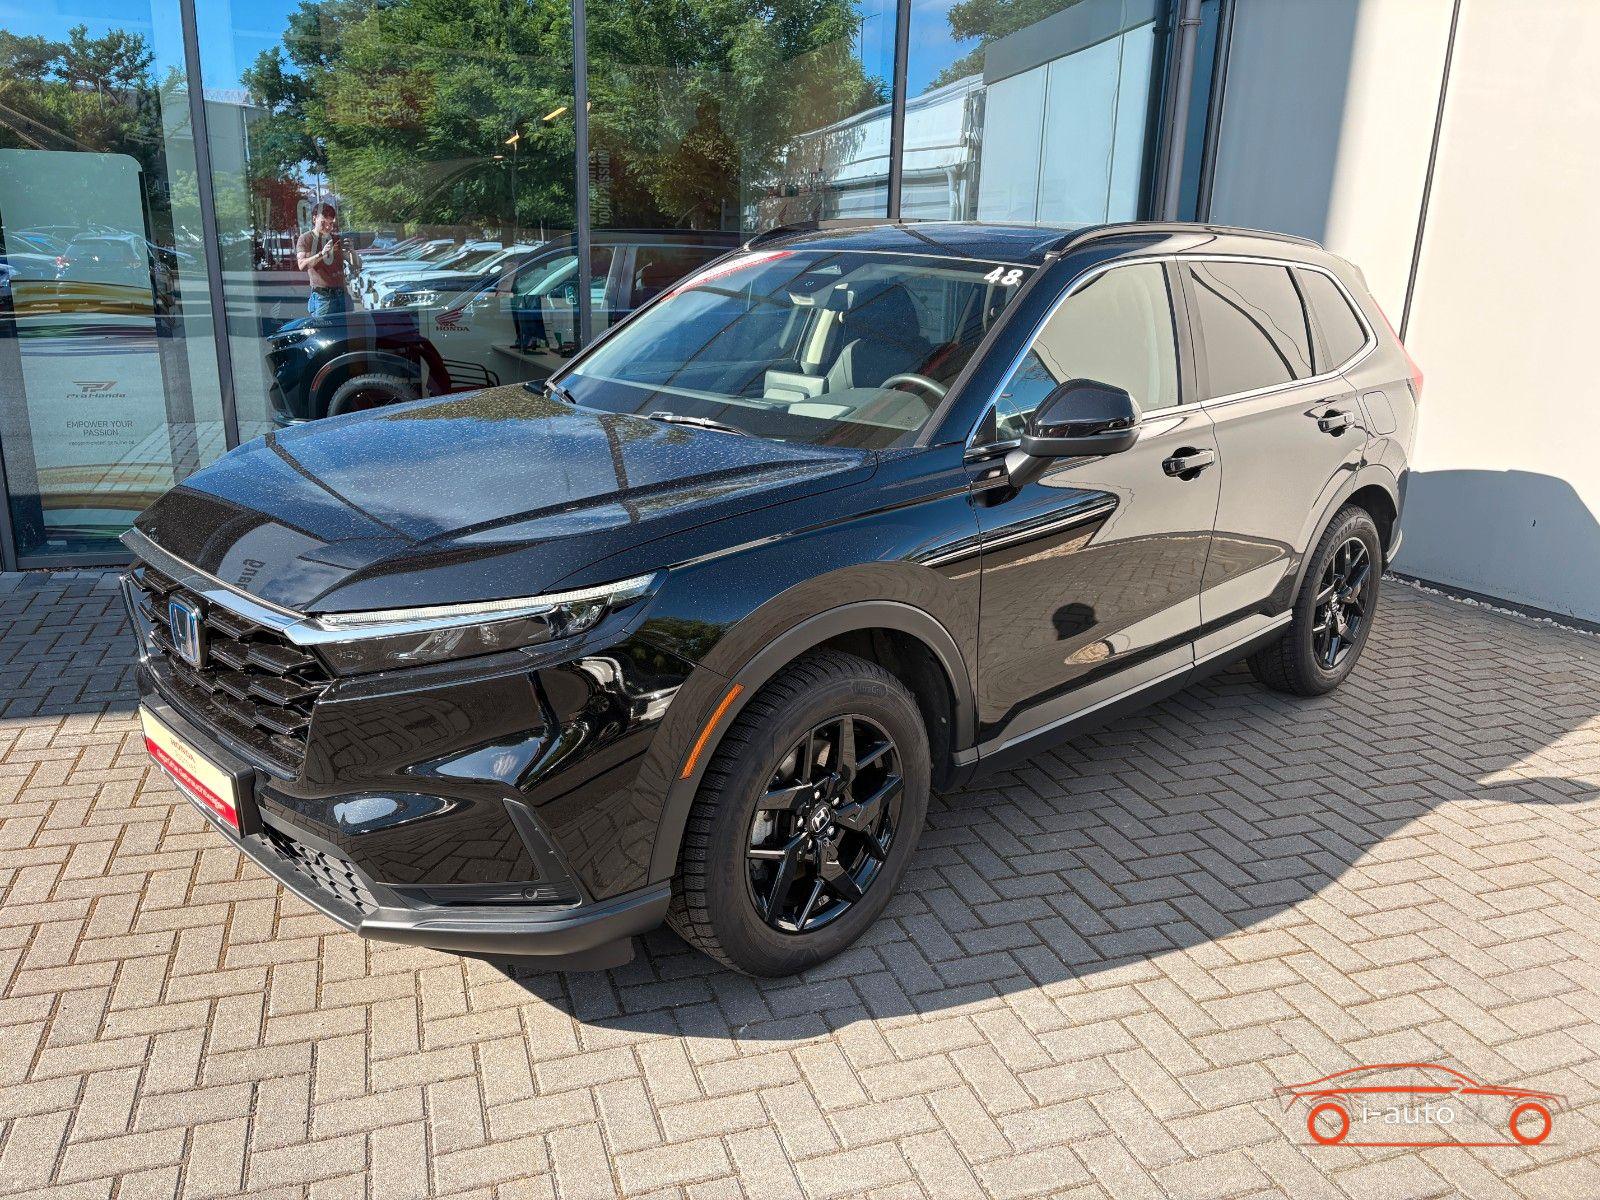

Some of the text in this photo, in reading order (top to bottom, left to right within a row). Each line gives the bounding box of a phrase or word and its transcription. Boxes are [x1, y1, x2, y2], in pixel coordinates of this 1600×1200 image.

[983, 266, 1024, 285] 48
[66, 420, 134, 428] EMPOWER YOUR
[83, 428, 119, 437] PASSION
